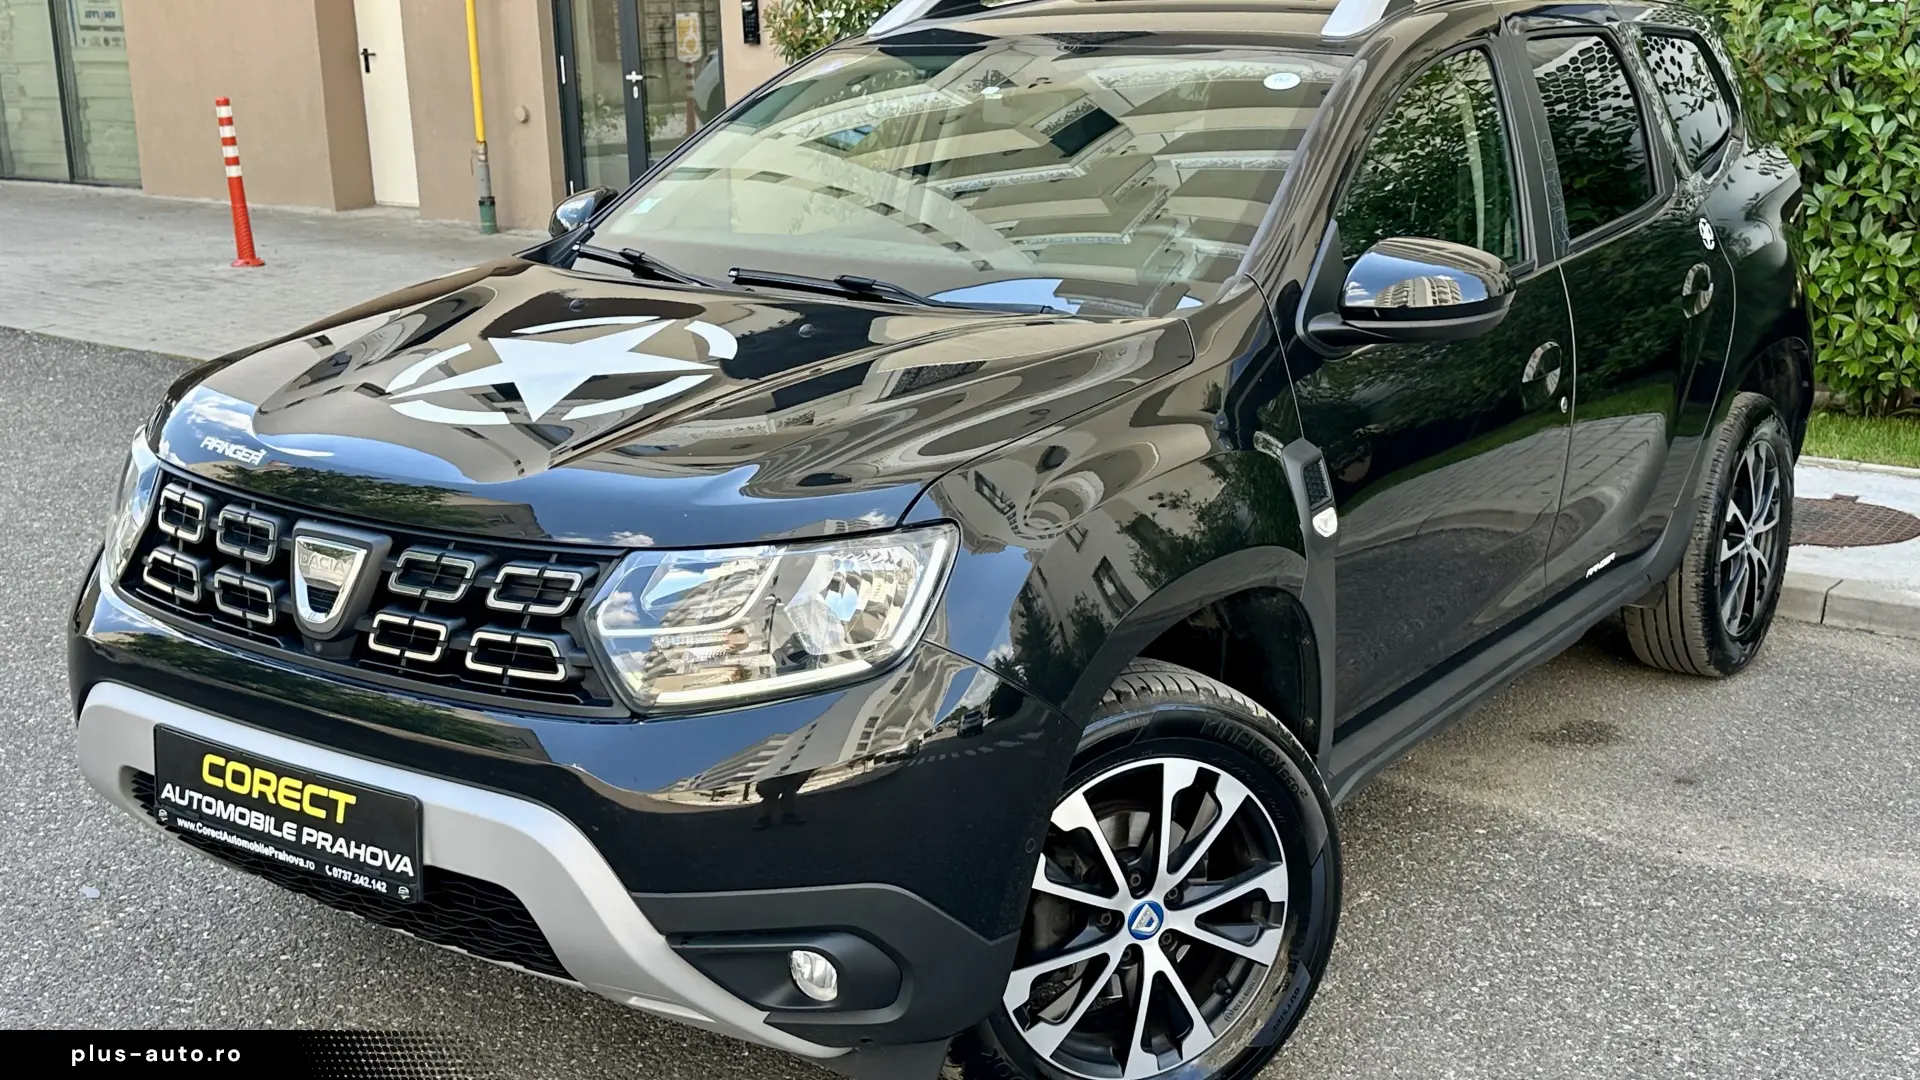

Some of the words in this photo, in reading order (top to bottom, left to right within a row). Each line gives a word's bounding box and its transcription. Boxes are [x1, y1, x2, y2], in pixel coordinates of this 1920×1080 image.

[200, 435, 268, 466] RANGER
[300, 552, 346, 573] DACIA
[202, 753, 357, 824] CORECT
[161, 782, 298, 842] AUTOMOBILE
[301, 826, 415, 877] PRAHOVA
[177, 817, 316, 871] www.CorectAutomobilePrahova.ro
[332, 866, 388, 893] 0737.242.142
